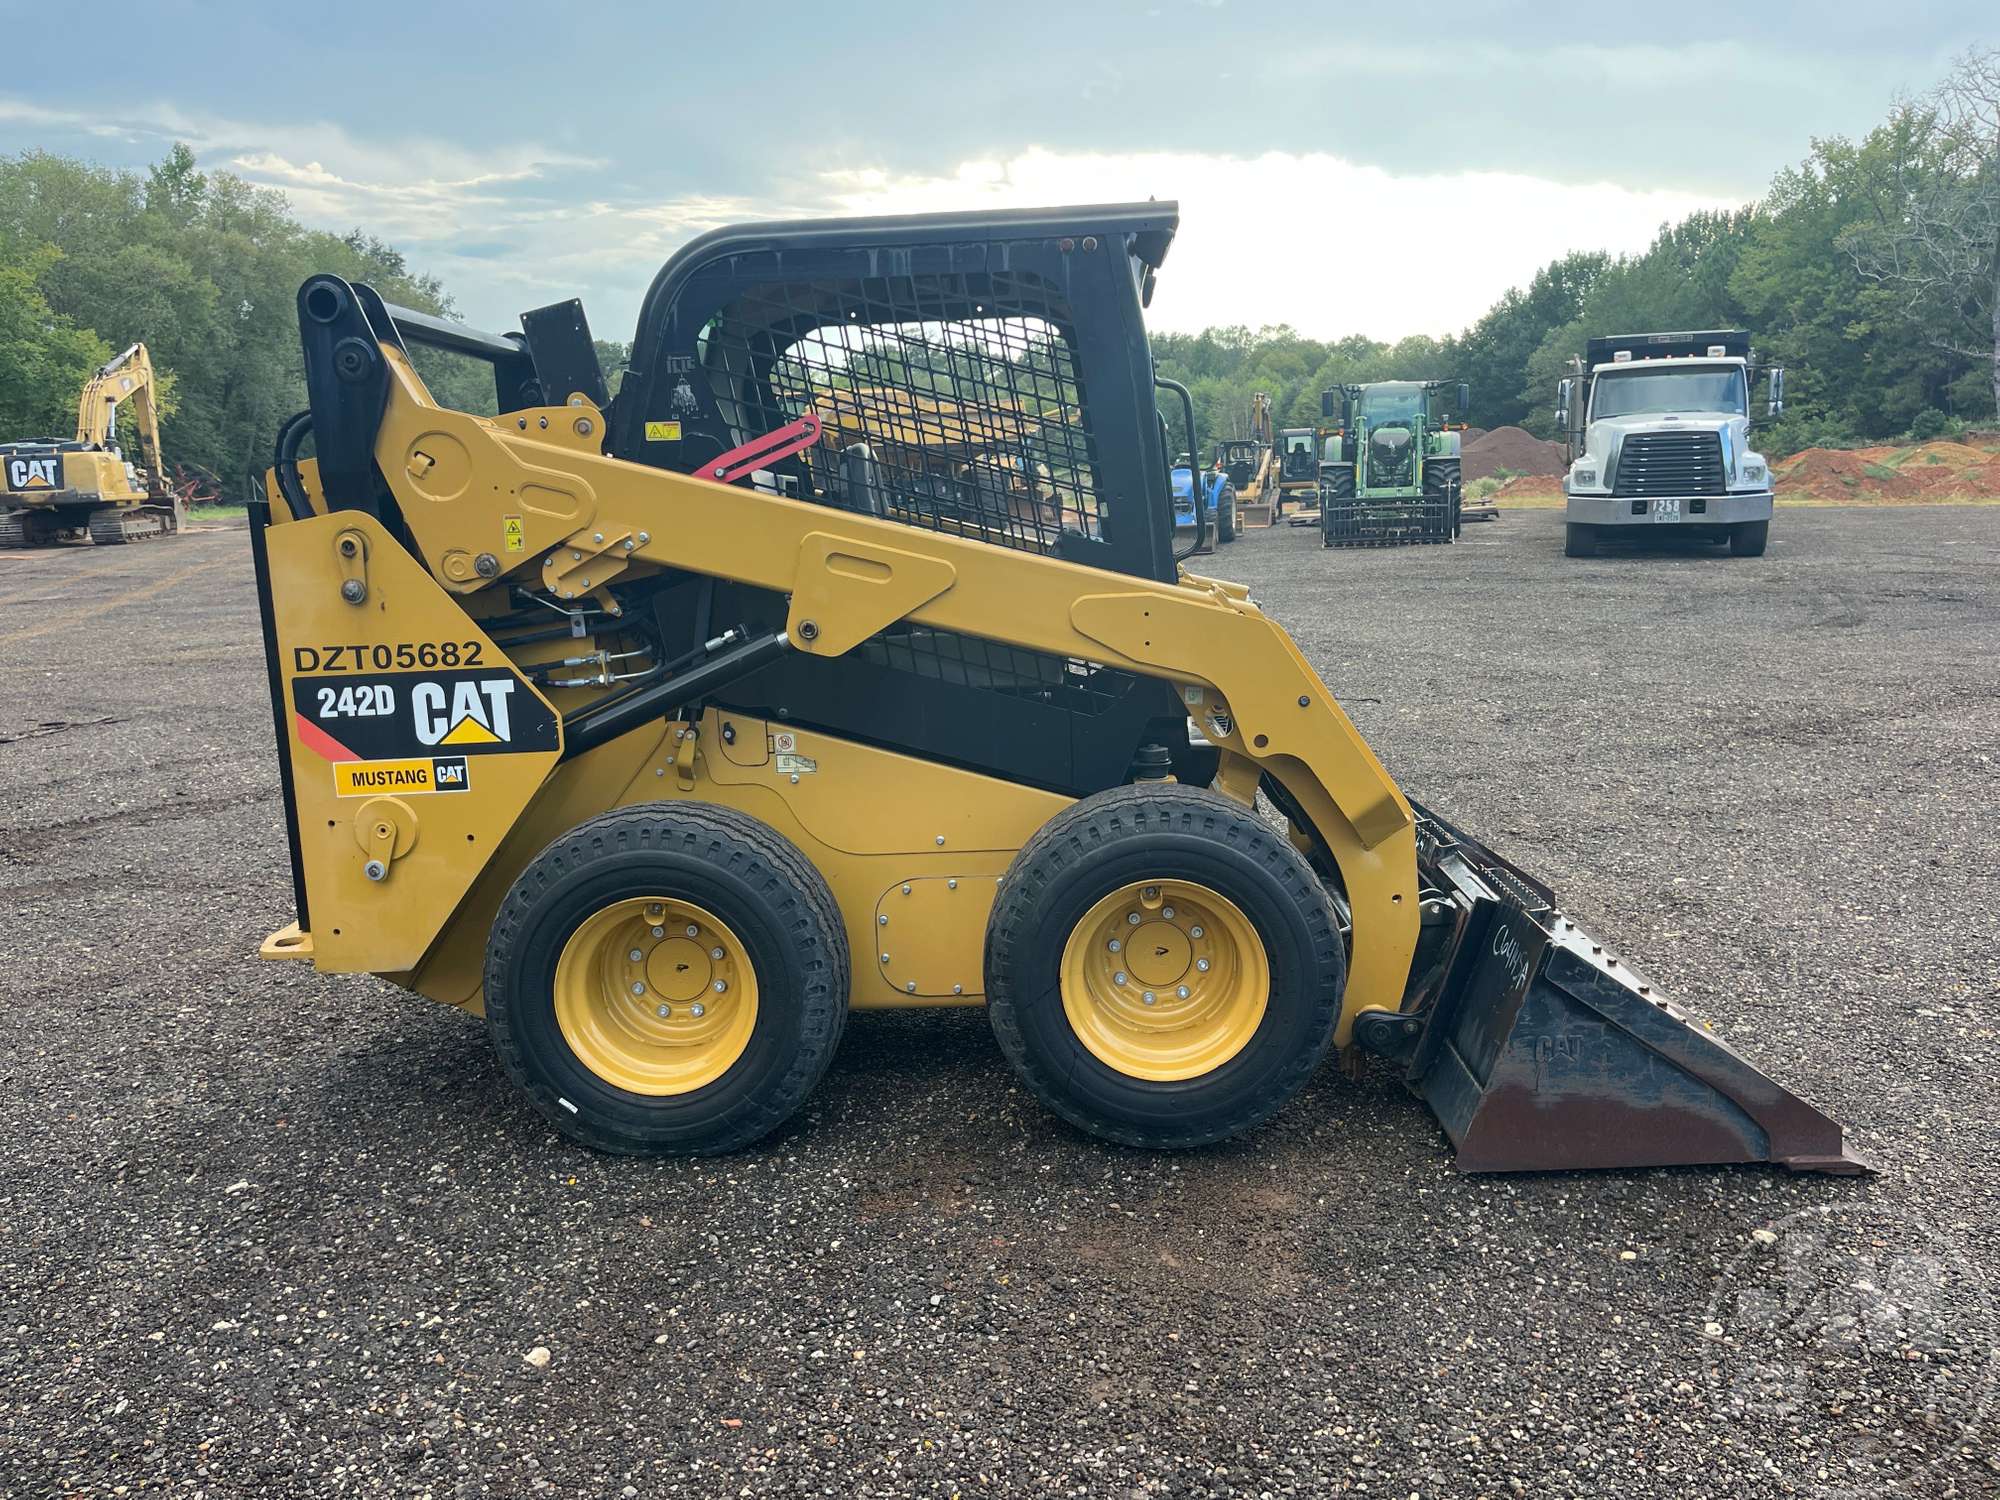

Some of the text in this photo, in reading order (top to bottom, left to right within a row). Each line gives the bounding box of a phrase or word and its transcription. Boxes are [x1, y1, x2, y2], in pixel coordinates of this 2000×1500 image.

[11, 460, 57, 487] CAT
[294, 641, 483, 672] DZT05682
[317, 679, 515, 746] 242D CAT
[352, 765, 464, 787] MUSTANG CAT
[1537, 1035, 1583, 1063] CAT
